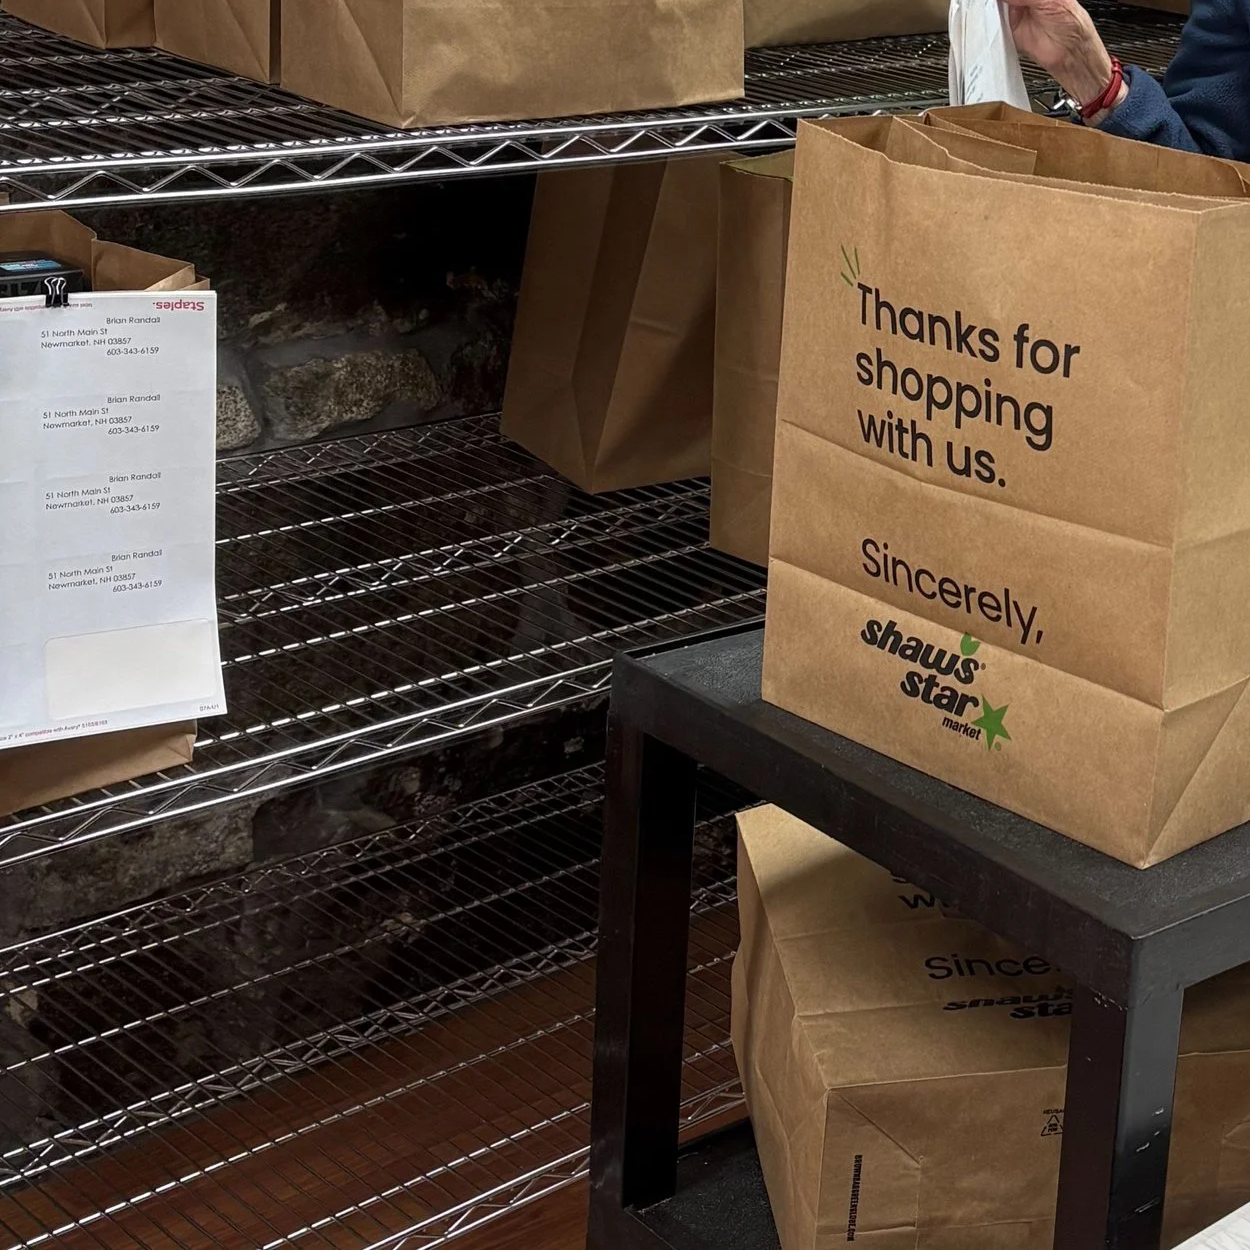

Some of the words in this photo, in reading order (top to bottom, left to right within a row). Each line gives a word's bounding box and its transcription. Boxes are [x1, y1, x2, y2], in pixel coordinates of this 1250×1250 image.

[41, 330, 49, 338] 51
[857, 281, 1001, 364] Thanks
[1013, 323, 1080, 379] for
[41, 339, 91, 349] Newmarket,
[108, 337, 132, 345] 03857
[107, 347, 160, 356] 603-343-6159
[107, 396, 128, 404] Brian
[855, 348, 1054, 452] shopping
[43, 411, 51, 419] 51
[54, 410, 77, 418] North
[79, 408, 99, 416] Main
[43, 420, 93, 430] Newmarket,
[109, 416, 132, 424] 03857
[108, 425, 160, 435] 603-343-6159
[857, 409, 933, 468] with
[946, 442, 1006, 488] us.
[109, 475, 129, 483] Brian
[46, 492, 54, 500] 51
[57, 490, 80, 498] North
[110, 495, 133, 503] 03857
[860, 537, 1044, 645] Sincerely,
[900, 671, 979, 717] star
[942, 717, 981, 740] market
[925, 954, 1061, 980] Since
[1009, 998, 1074, 1020] sta
